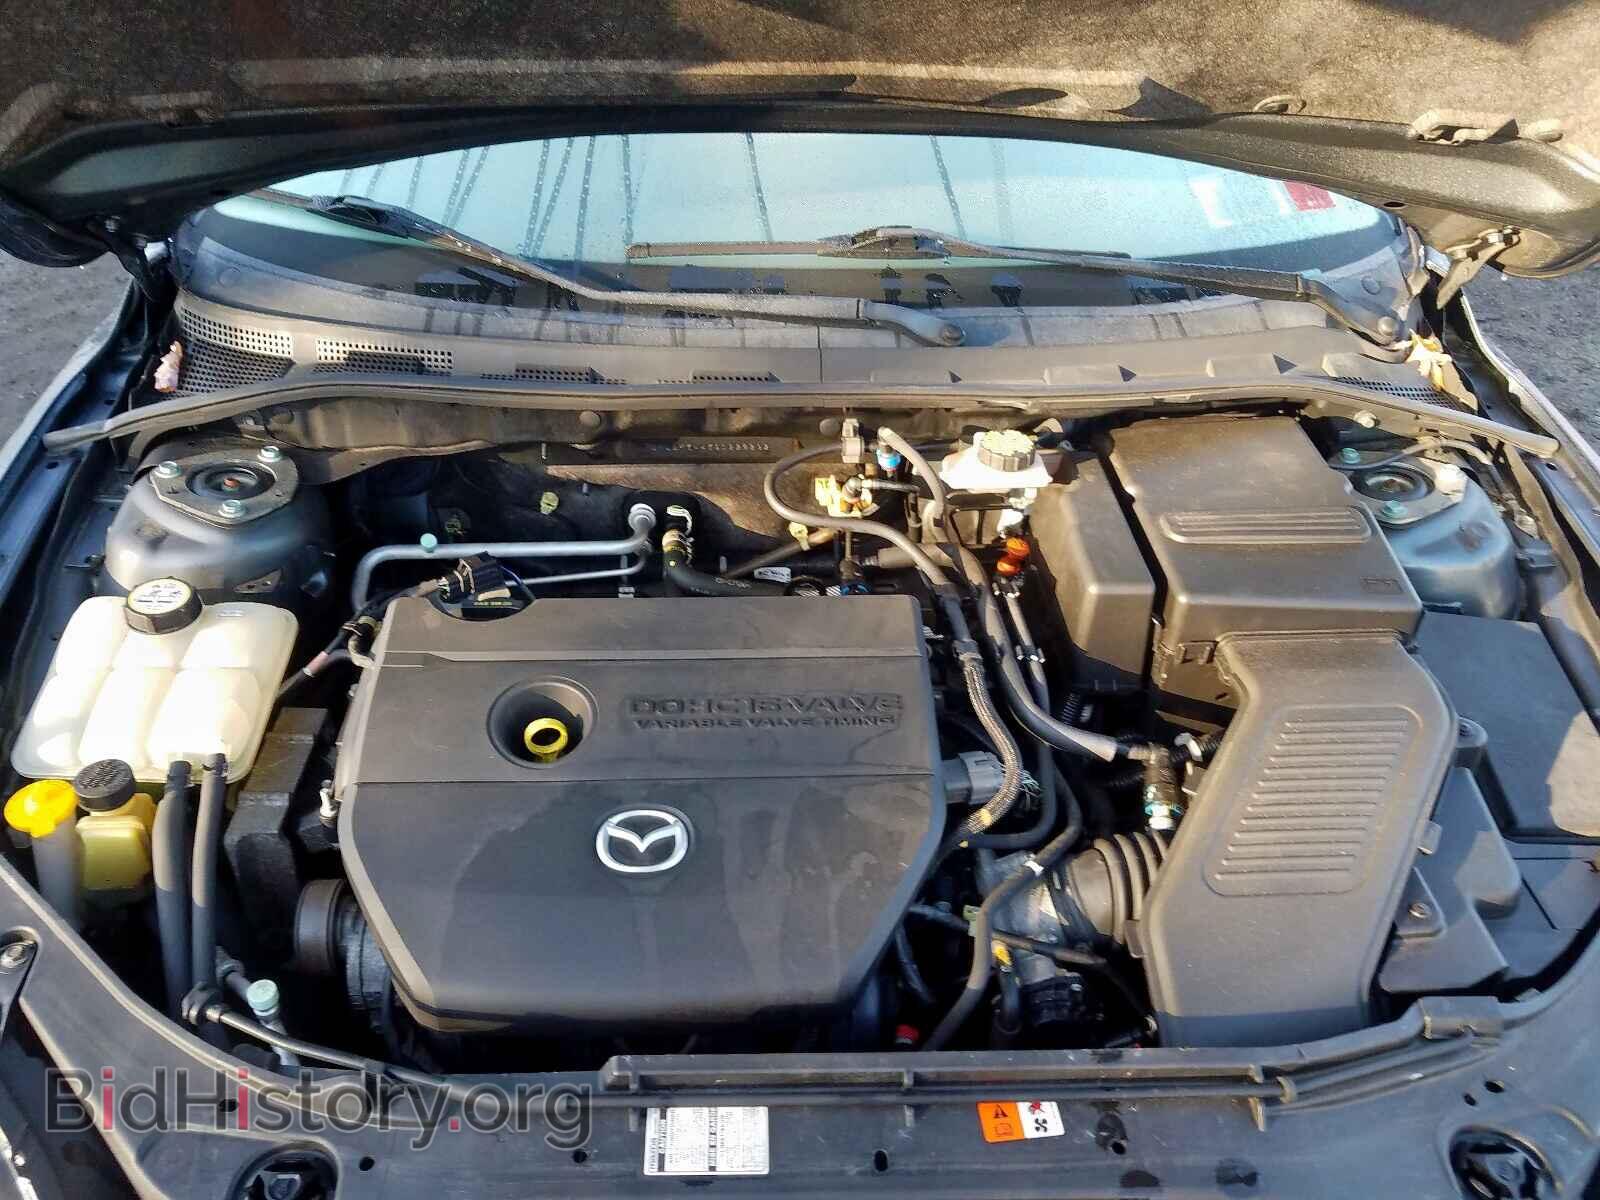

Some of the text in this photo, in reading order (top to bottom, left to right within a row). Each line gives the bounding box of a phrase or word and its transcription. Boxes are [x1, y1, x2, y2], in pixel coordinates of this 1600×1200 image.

[632, 698, 741, 714] DOHC
[786, 696, 902, 714] VALVE
[632, 718, 743, 730] VARIABLE
